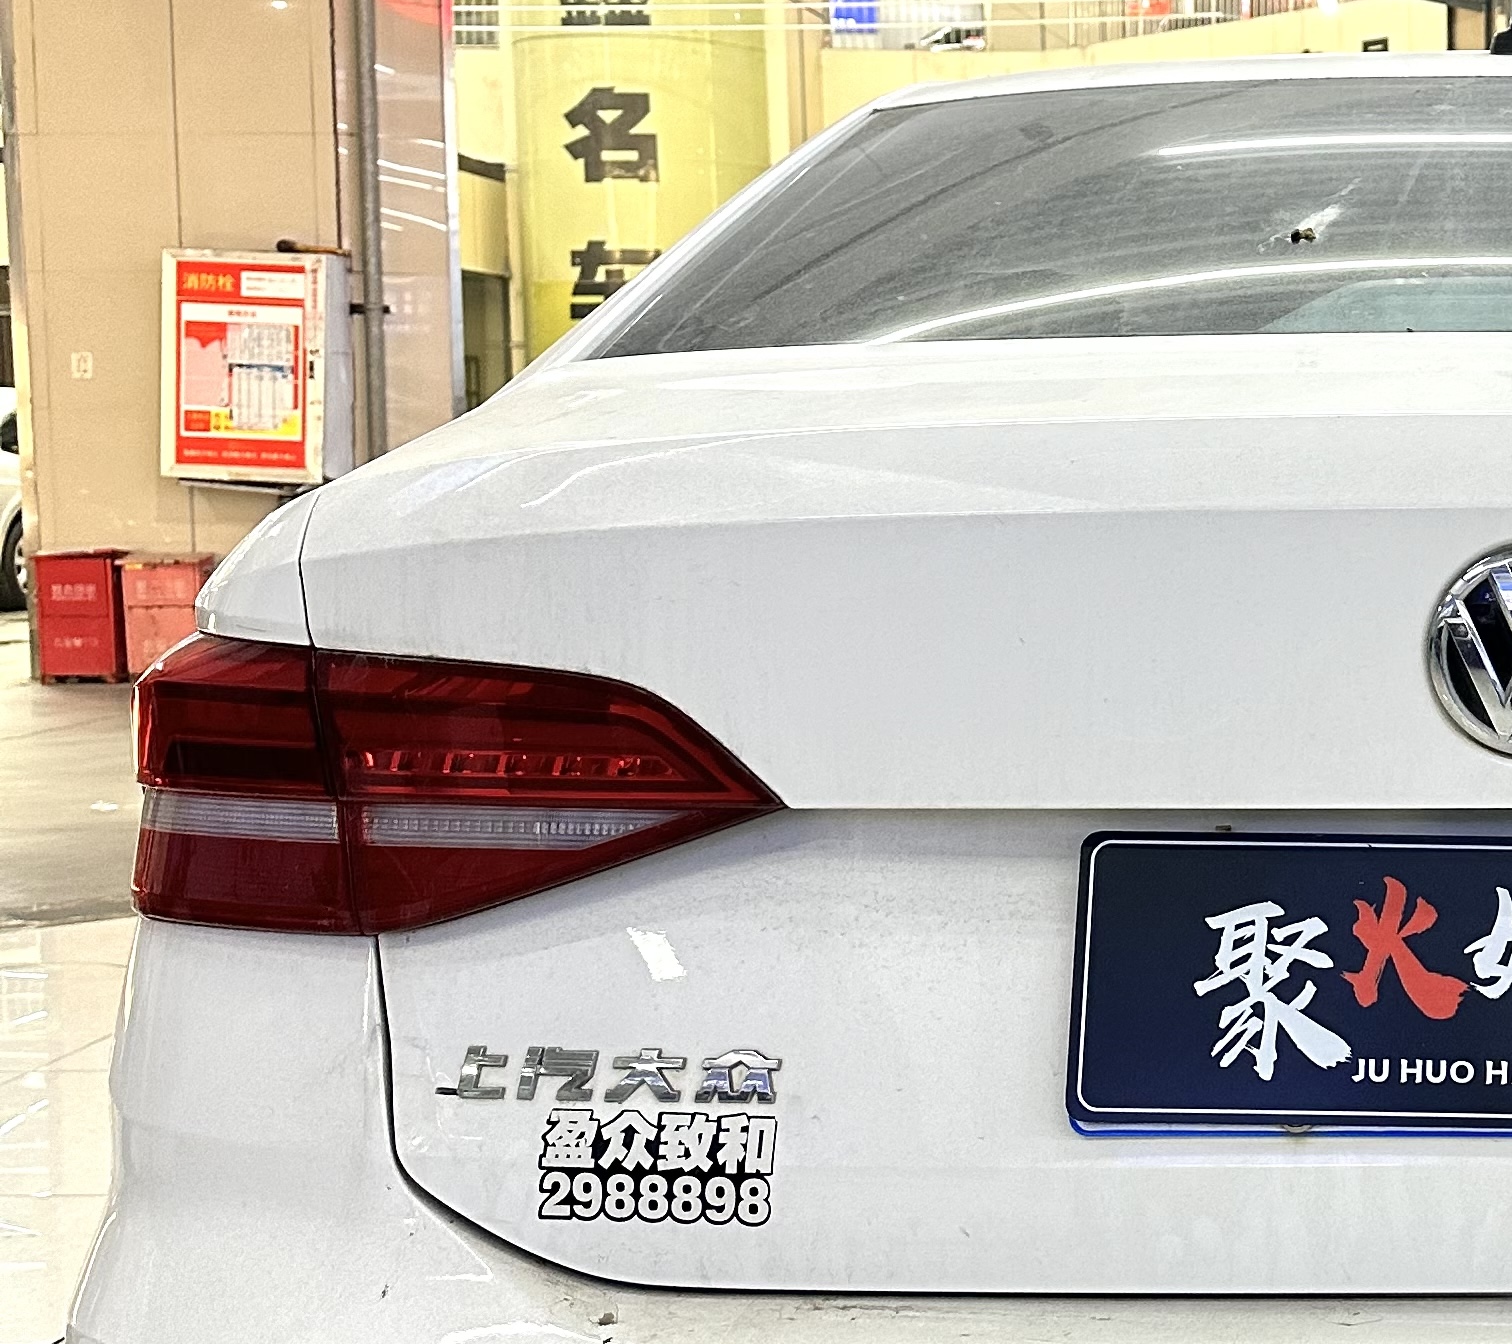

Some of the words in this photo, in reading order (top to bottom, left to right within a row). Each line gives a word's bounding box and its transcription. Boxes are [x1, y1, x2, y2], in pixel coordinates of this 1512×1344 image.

[183, 272, 236, 292] 消防栓
[435, 1045, 783, 1105] 上汽大众
[1352, 1058, 1391, 1083] JU
[1400, 1059, 1475, 1085] HUO
[537, 1108, 778, 1176] 盈众致和
[537, 1170, 772, 1227] 2988898
